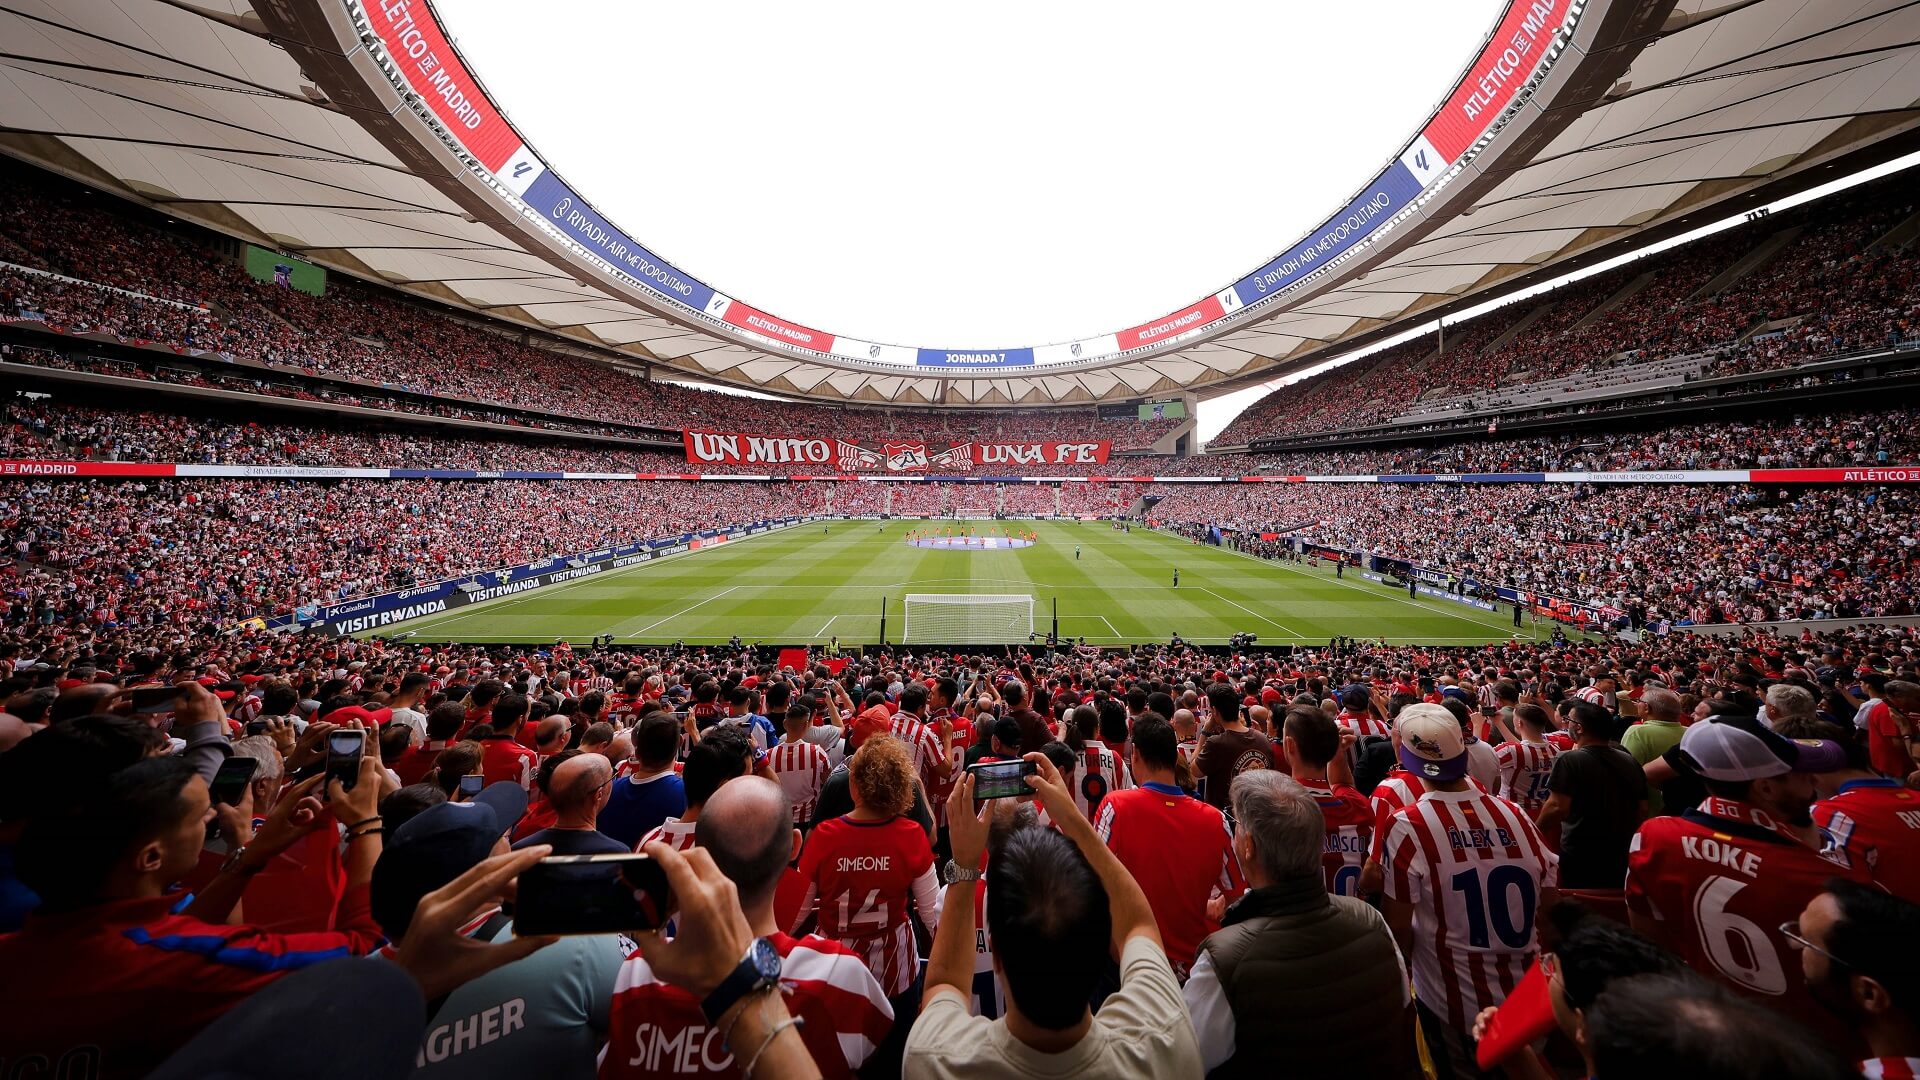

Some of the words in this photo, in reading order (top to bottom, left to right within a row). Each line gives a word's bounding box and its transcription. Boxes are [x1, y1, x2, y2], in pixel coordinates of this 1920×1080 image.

[1462, 48, 1520, 121] ATLÉTICO
[428, 69, 482, 130] MADRID
[1265, 260, 1302, 285] RIYADH
[1299, 248, 1320, 268] AIR
[1315, 192, 1390, 254] METROPOLITANO
[567, 210, 609, 247] RIYADH
[606, 242, 628, 260] AIR
[625, 252, 693, 296] METROPOLITANO
[745, 315, 779, 332] ATLÉTICO
[783, 328, 812, 343] MADRID
[1138, 323, 1171, 340] ATLÉTICO
[1174, 310, 1202, 328] MADRID
[945, 353, 998, 363] JORNADA
[999, 353, 1006, 363] 7
[689, 432, 741, 461] UN
[746, 436, 831, 463] MITO
[980, 444, 1047, 465] UNA
[1054, 443, 1099, 463] FE
[19, 463, 77, 474] MADRID
[1844, 468, 1907, 481] ATLÉTICO
[549, 572, 570, 583] VISIT
[570, 563, 602, 578] RWANDA
[612, 557, 628, 568] VISIT
[627, 552, 652, 565] RWANDA
[1416, 569, 1439, 583] LALIGA
[411, 584, 441, 595] HYUNDAI
[468, 587, 496, 603] VISIT
[496, 577, 541, 597] RWANDA
[335, 612, 379, 636] VISIT
[380, 599, 447, 625] RWANDA
[339, 601, 372, 614] CaixaBank
[1475, 601, 1492, 610] LALIGA
[1449, 825, 1496, 849] ÁLEX
[1495, 828, 1519, 848] B.
[836, 856, 890, 872] SIMEONE
[1681, 836, 1763, 879] KOKE
[837, 889, 889, 934] 14
[1452, 865, 1536, 949] 10
[1693, 875, 1787, 996] 6
